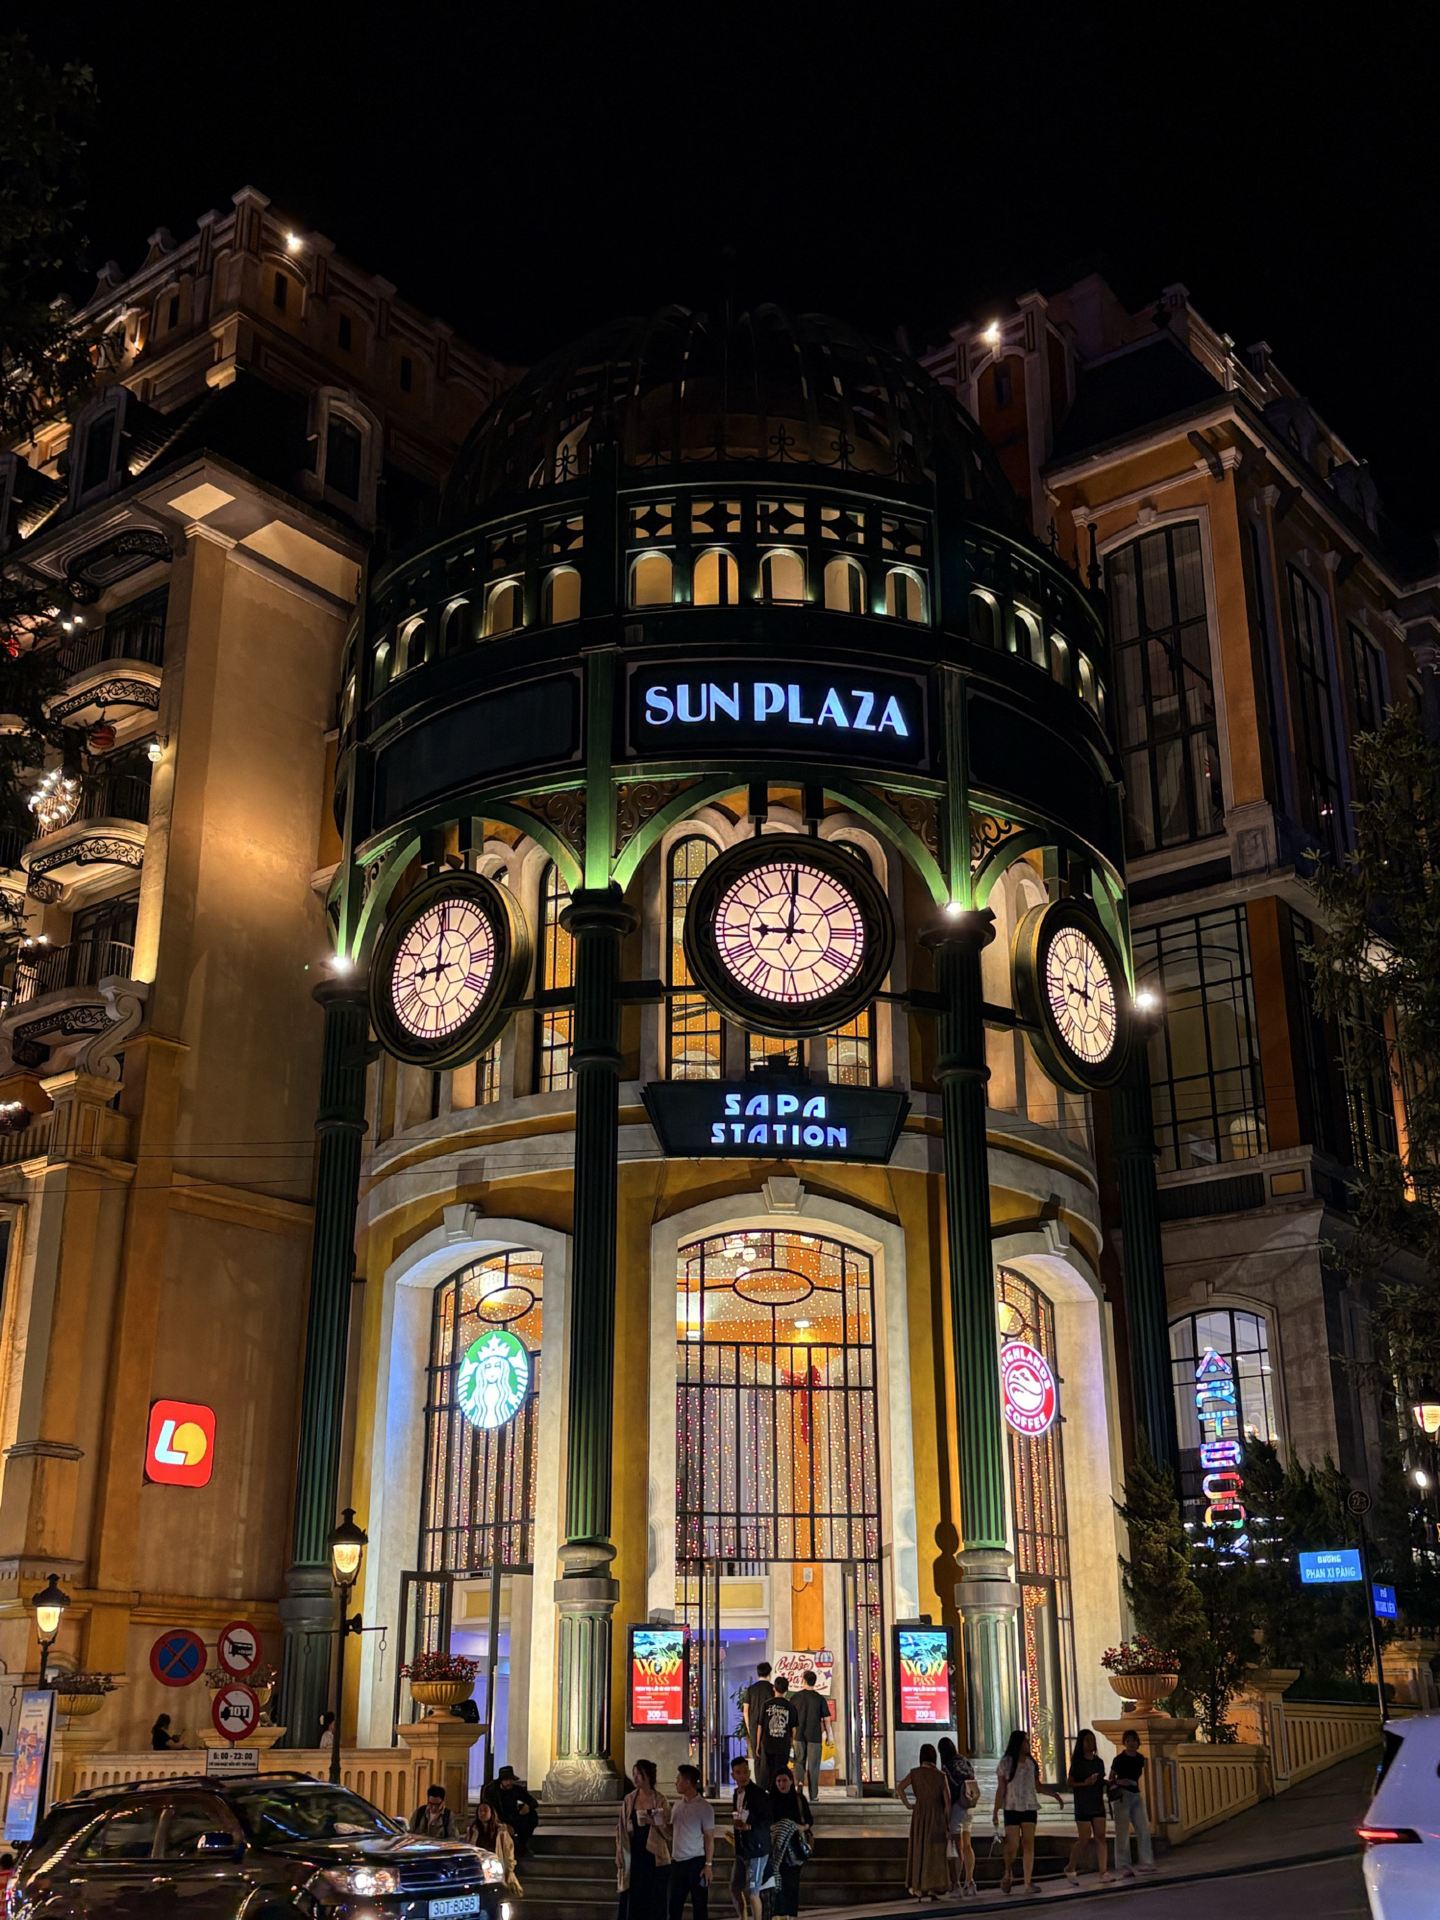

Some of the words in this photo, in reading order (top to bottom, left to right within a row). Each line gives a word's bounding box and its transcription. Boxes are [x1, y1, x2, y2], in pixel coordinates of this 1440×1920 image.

[645, 681, 740, 726] SUN
[753, 681, 909, 738] PLAZA
[723, 1092, 828, 1119] SAPA
[710, 1122, 847, 1148] STATION
[1194, 1350, 1239, 1438] ART
[1005, 1403, 1047, 1430] COFFEE
[1305, 1568, 1326, 1580] PHAN
[646, 1676, 670, 1686] PASS
[912, 1676, 936, 1687] PASS
[229, 1706, 249, 1717] 10T
